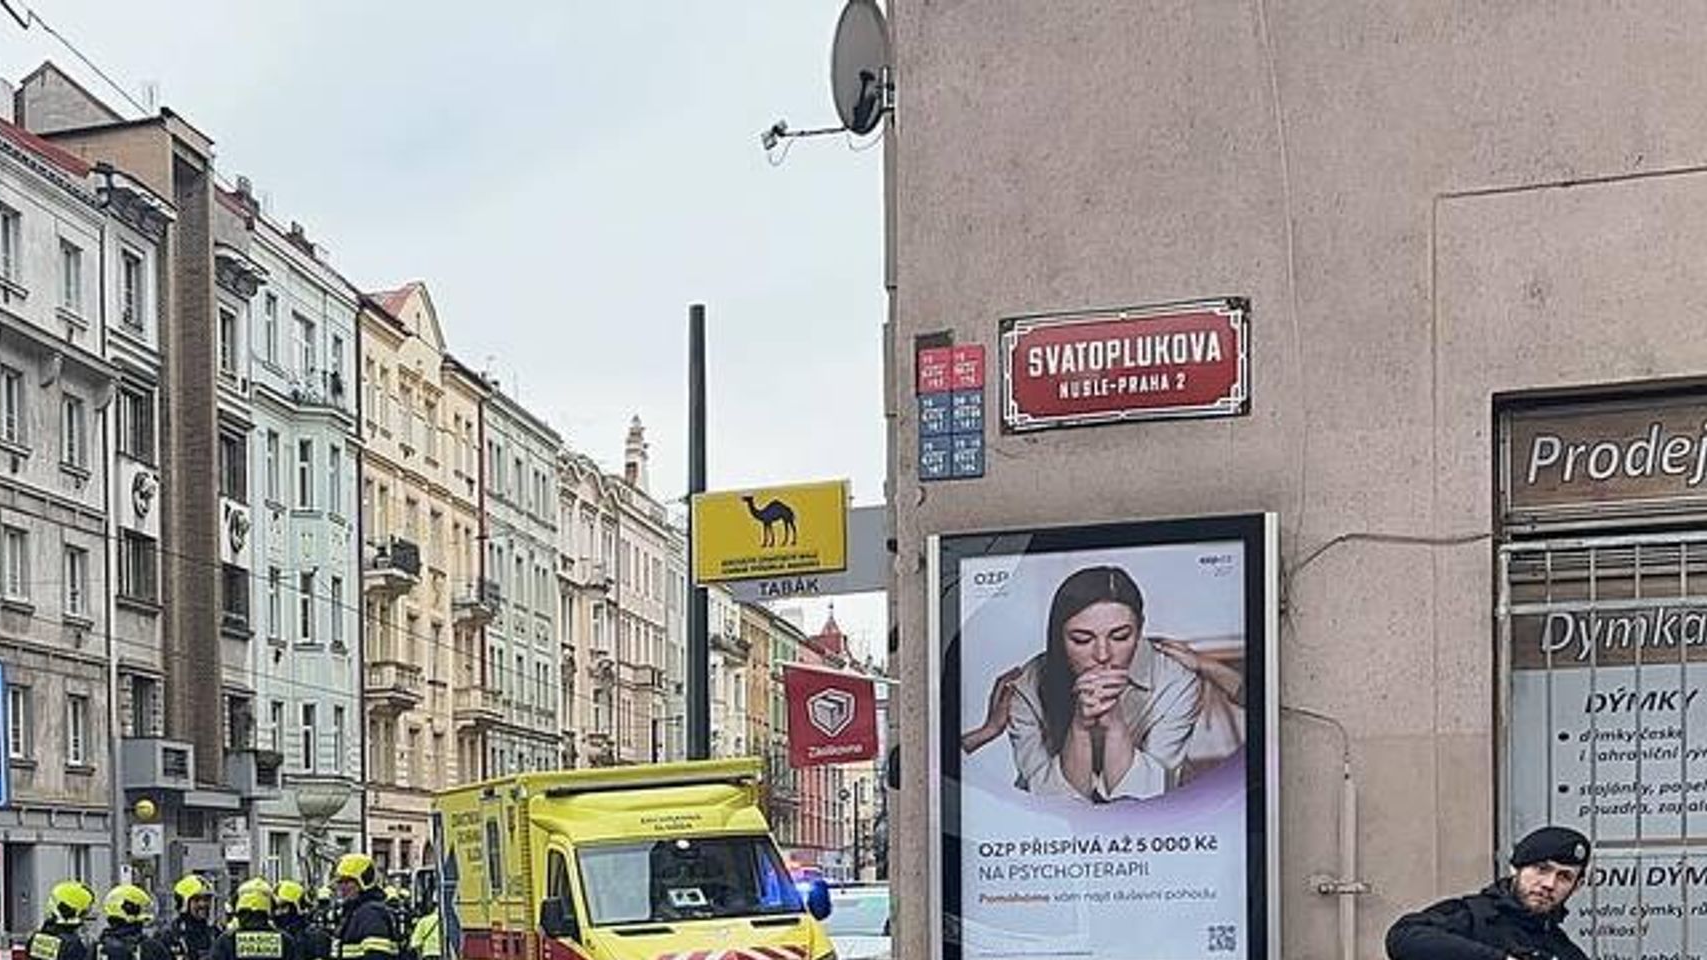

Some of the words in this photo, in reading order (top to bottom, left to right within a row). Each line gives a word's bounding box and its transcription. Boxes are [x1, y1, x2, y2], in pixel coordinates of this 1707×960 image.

[1028, 331, 1222, 377] SVATOPLUKOVA
[1059, 375, 1170, 399] NUSLE-PRAHA
[1176, 373, 1187, 391] 2
[1527, 423, 1707, 485] Prodej
[759, 577, 819, 596] TABÁK
[1585, 686, 1698, 713] DÝMKY
[979, 842, 1015, 857] OZP
[1020, 836, 1101, 856] PŘISPÍVÁ
[1108, 836, 1132, 853] AŽ
[1136, 838, 1147, 852] 5
[1151, 837, 1191, 851] 000
[1195, 836, 1218, 851] Kč
[979, 865, 1005, 881] NA
